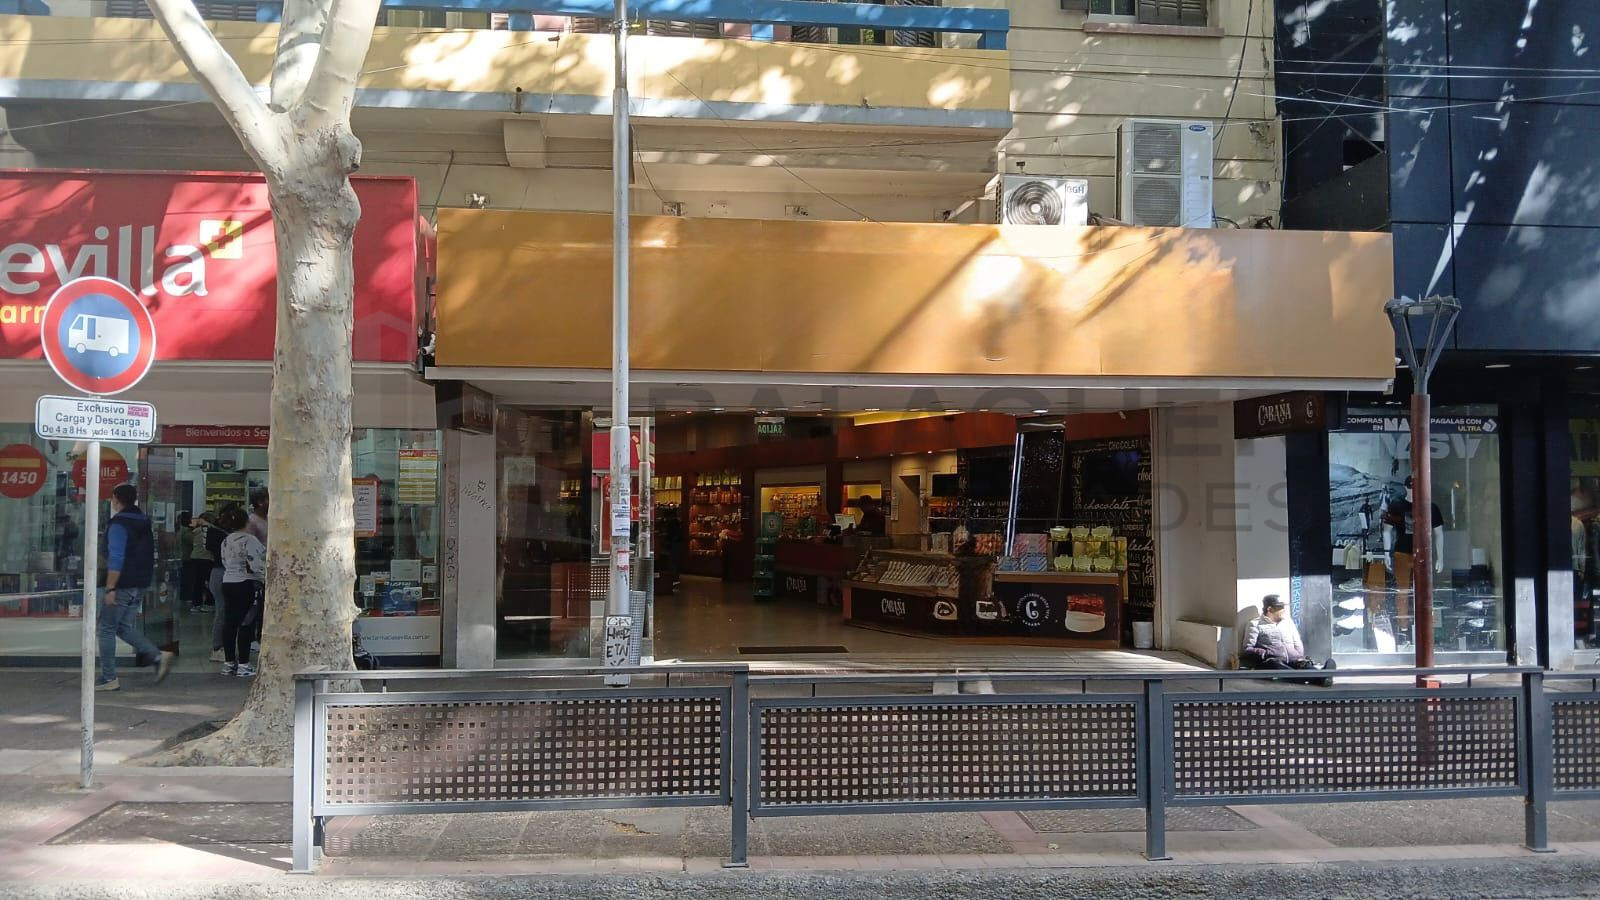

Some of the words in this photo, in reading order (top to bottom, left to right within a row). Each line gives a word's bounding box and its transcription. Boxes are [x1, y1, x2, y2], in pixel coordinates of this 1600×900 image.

[77, 402, 125, 414] Exclusivo
[1258, 399, 1292, 426] CABAÑA
[55, 412, 85, 424] Carga
[86, 415, 93, 425] y
[95, 415, 141, 427] Descarga
[42, 425, 54, 433] De
[69, 426, 74, 434] 8
[111, 428, 119, 436] 14
[128, 429, 137, 437] 16
[185, 427, 241, 437] Bienvenidos
[2, 471, 38, 484] 1450
[82, 467, 116, 477] Silla
[1084, 496, 1131, 510] chocolate
